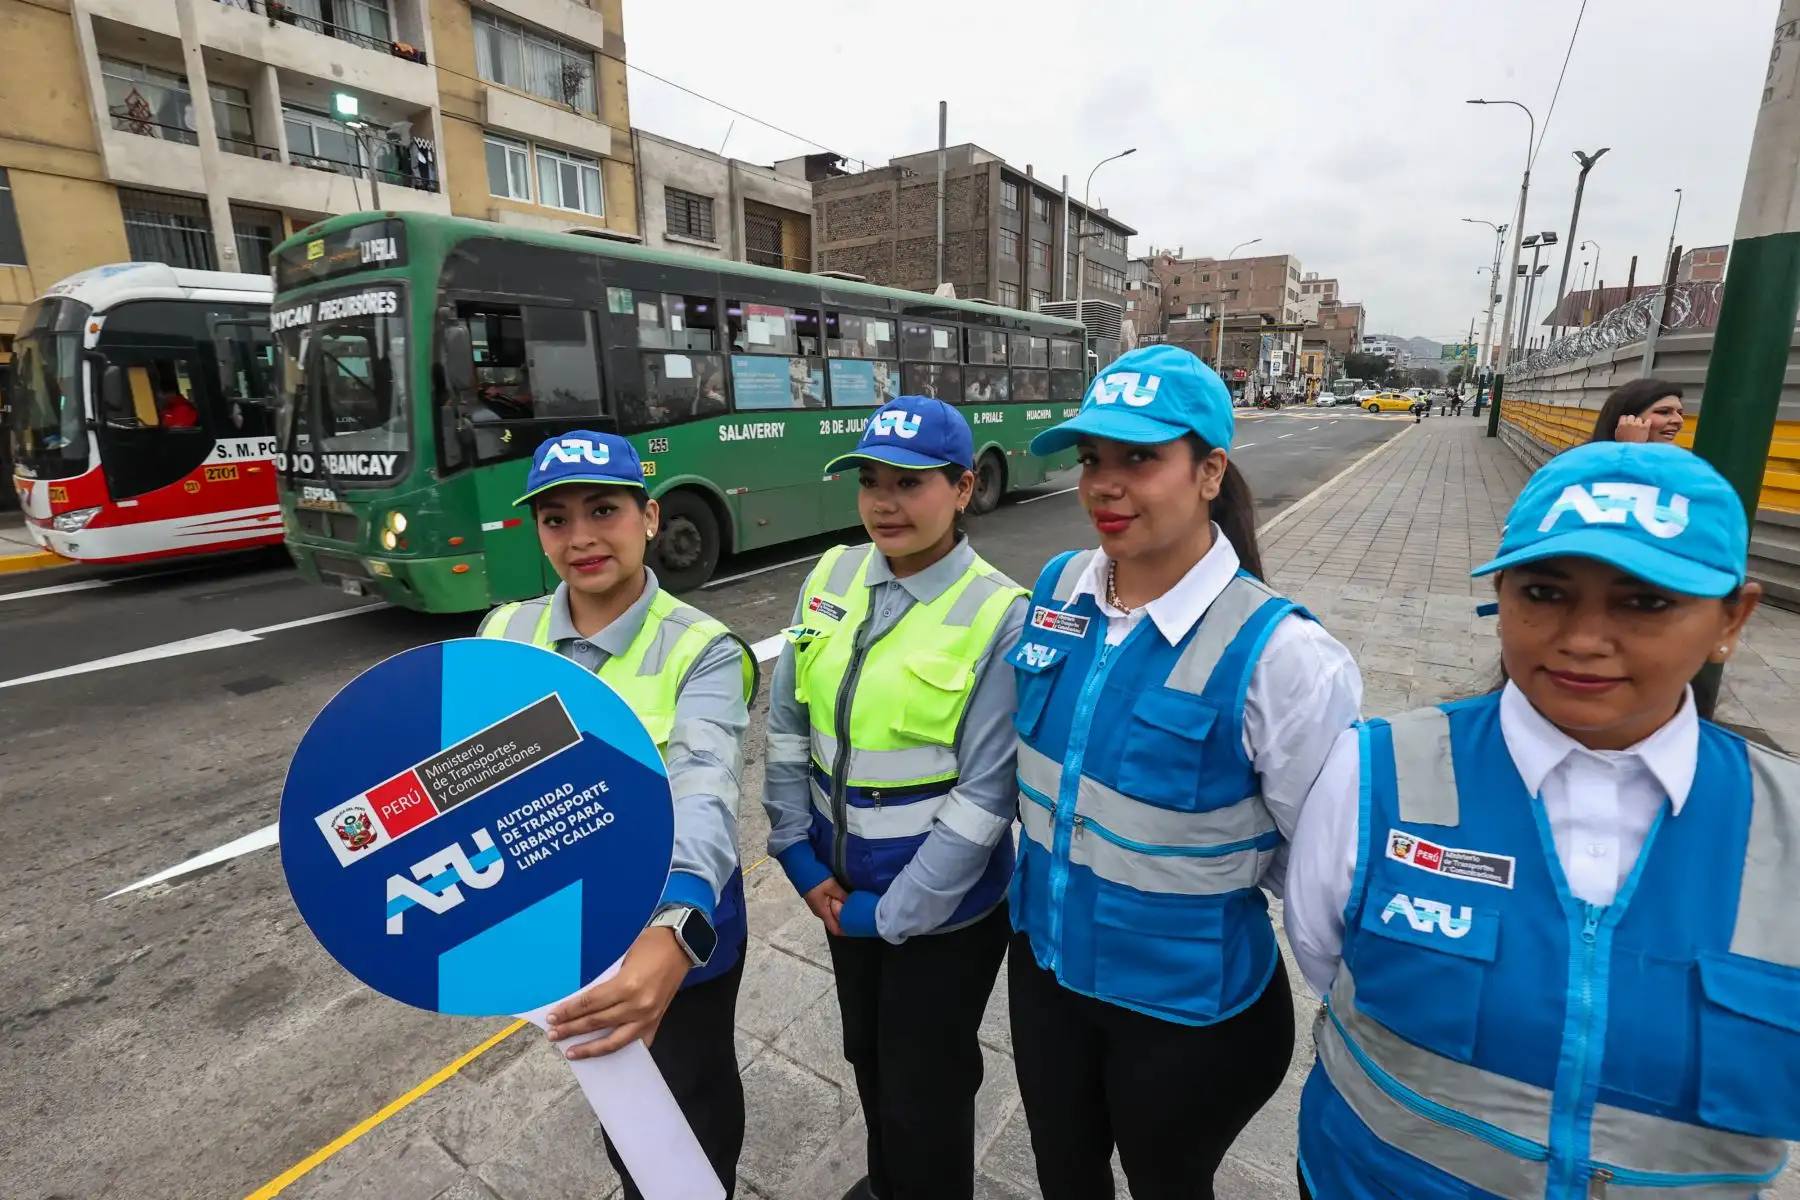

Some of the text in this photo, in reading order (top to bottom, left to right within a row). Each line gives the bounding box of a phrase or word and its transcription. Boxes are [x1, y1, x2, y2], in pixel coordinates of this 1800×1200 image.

[371, 237, 397, 261] PERLA
[271, 291, 397, 333] AYCAN PRECURSORES
[1082, 372, 1162, 411] ATU
[819, 420, 830, 434] 28
[832, 420, 844, 434] DE
[863, 410, 922, 441] ATU
[981, 412, 1003, 423] PRIALE
[1026, 409, 1051, 420] HUACHIPA
[650, 439, 667, 452] 255
[719, 422, 785, 441] SALAVERRY
[217, 444, 232, 458] S.
[236, 443, 254, 457] M.
[539, 439, 610, 471] ATU
[206, 467, 236, 480] 2701
[1537, 482, 1690, 539] ATU
[1016, 642, 1057, 667] ATU
[425, 743, 485, 780] Ministerio
[432, 740, 517, 791] de Transportes
[438, 742, 541, 804] y Comunicaciones
[381, 787, 421, 820] PERÚ
[496, 783, 574, 831] AUTORIDAD
[501, 780, 609, 845] DE TRANSPORTE
[509, 801, 604, 857] URBANO PARA
[516, 812, 615, 870] LIMA Y CALLAO
[1416, 849, 1440, 863] PERÚ
[1445, 851, 1481, 862] Ministerio
[386, 827, 505, 935] ATU
[1381, 893, 1473, 938] ATU
